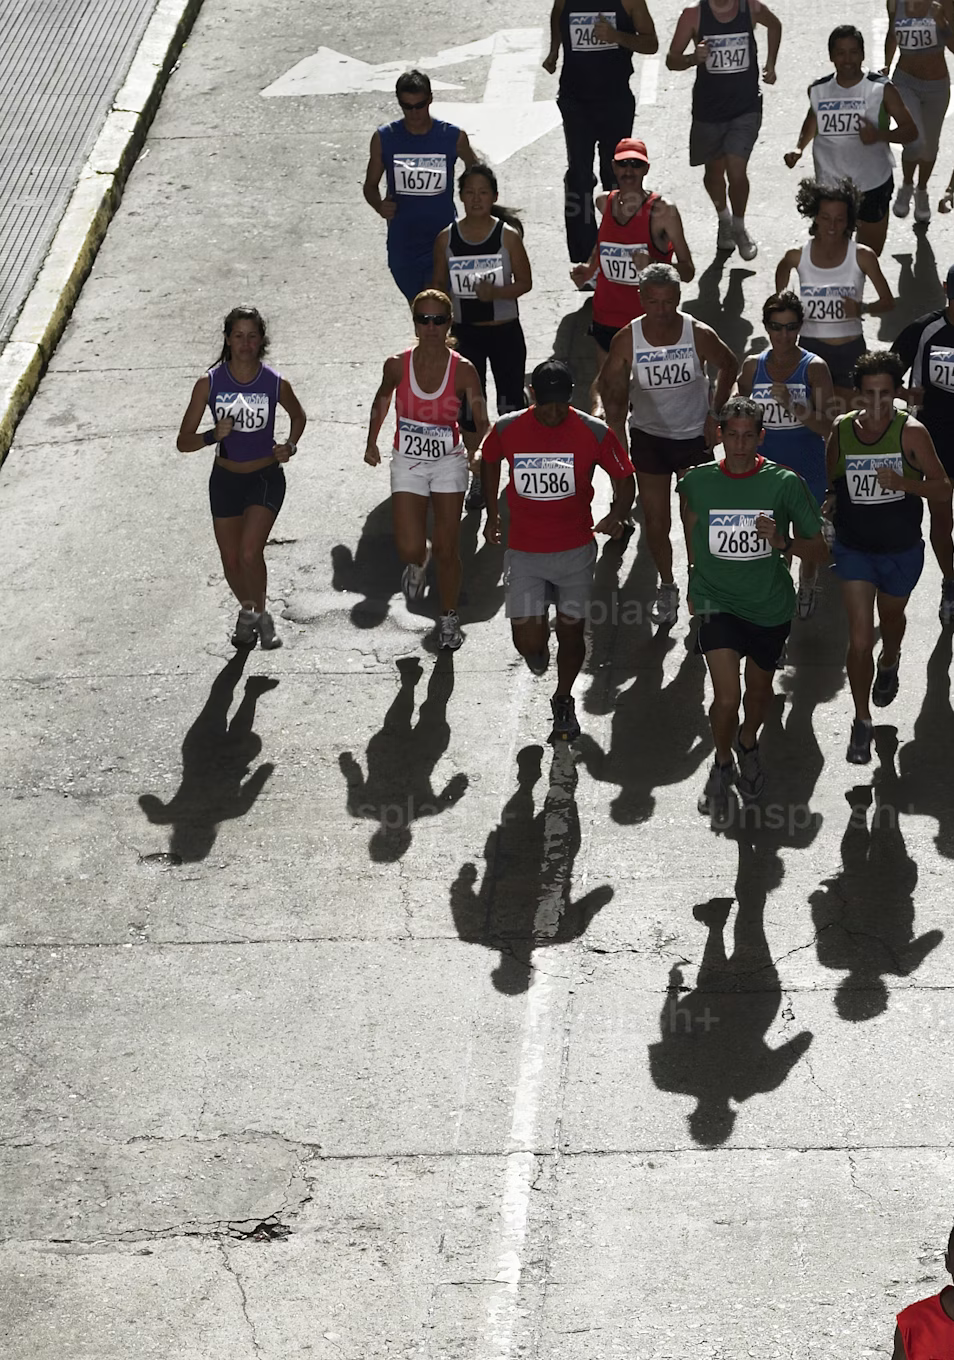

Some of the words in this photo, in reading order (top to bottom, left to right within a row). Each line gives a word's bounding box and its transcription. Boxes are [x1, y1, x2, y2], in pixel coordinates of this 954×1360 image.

[575, 28, 607, 46] 246
[896, 30, 932, 46] 27513
[711, 49, 746, 68] 21347
[822, 113, 860, 132] 24573
[418, 158, 445, 167] RunStyle
[401, 171, 442, 190] 16572
[605, 260, 640, 279] 1975
[808, 300, 846, 319] 2348
[652, 365, 694, 388] 15426
[404, 435, 446, 457] 23481
[521, 473, 569, 494] 21586
